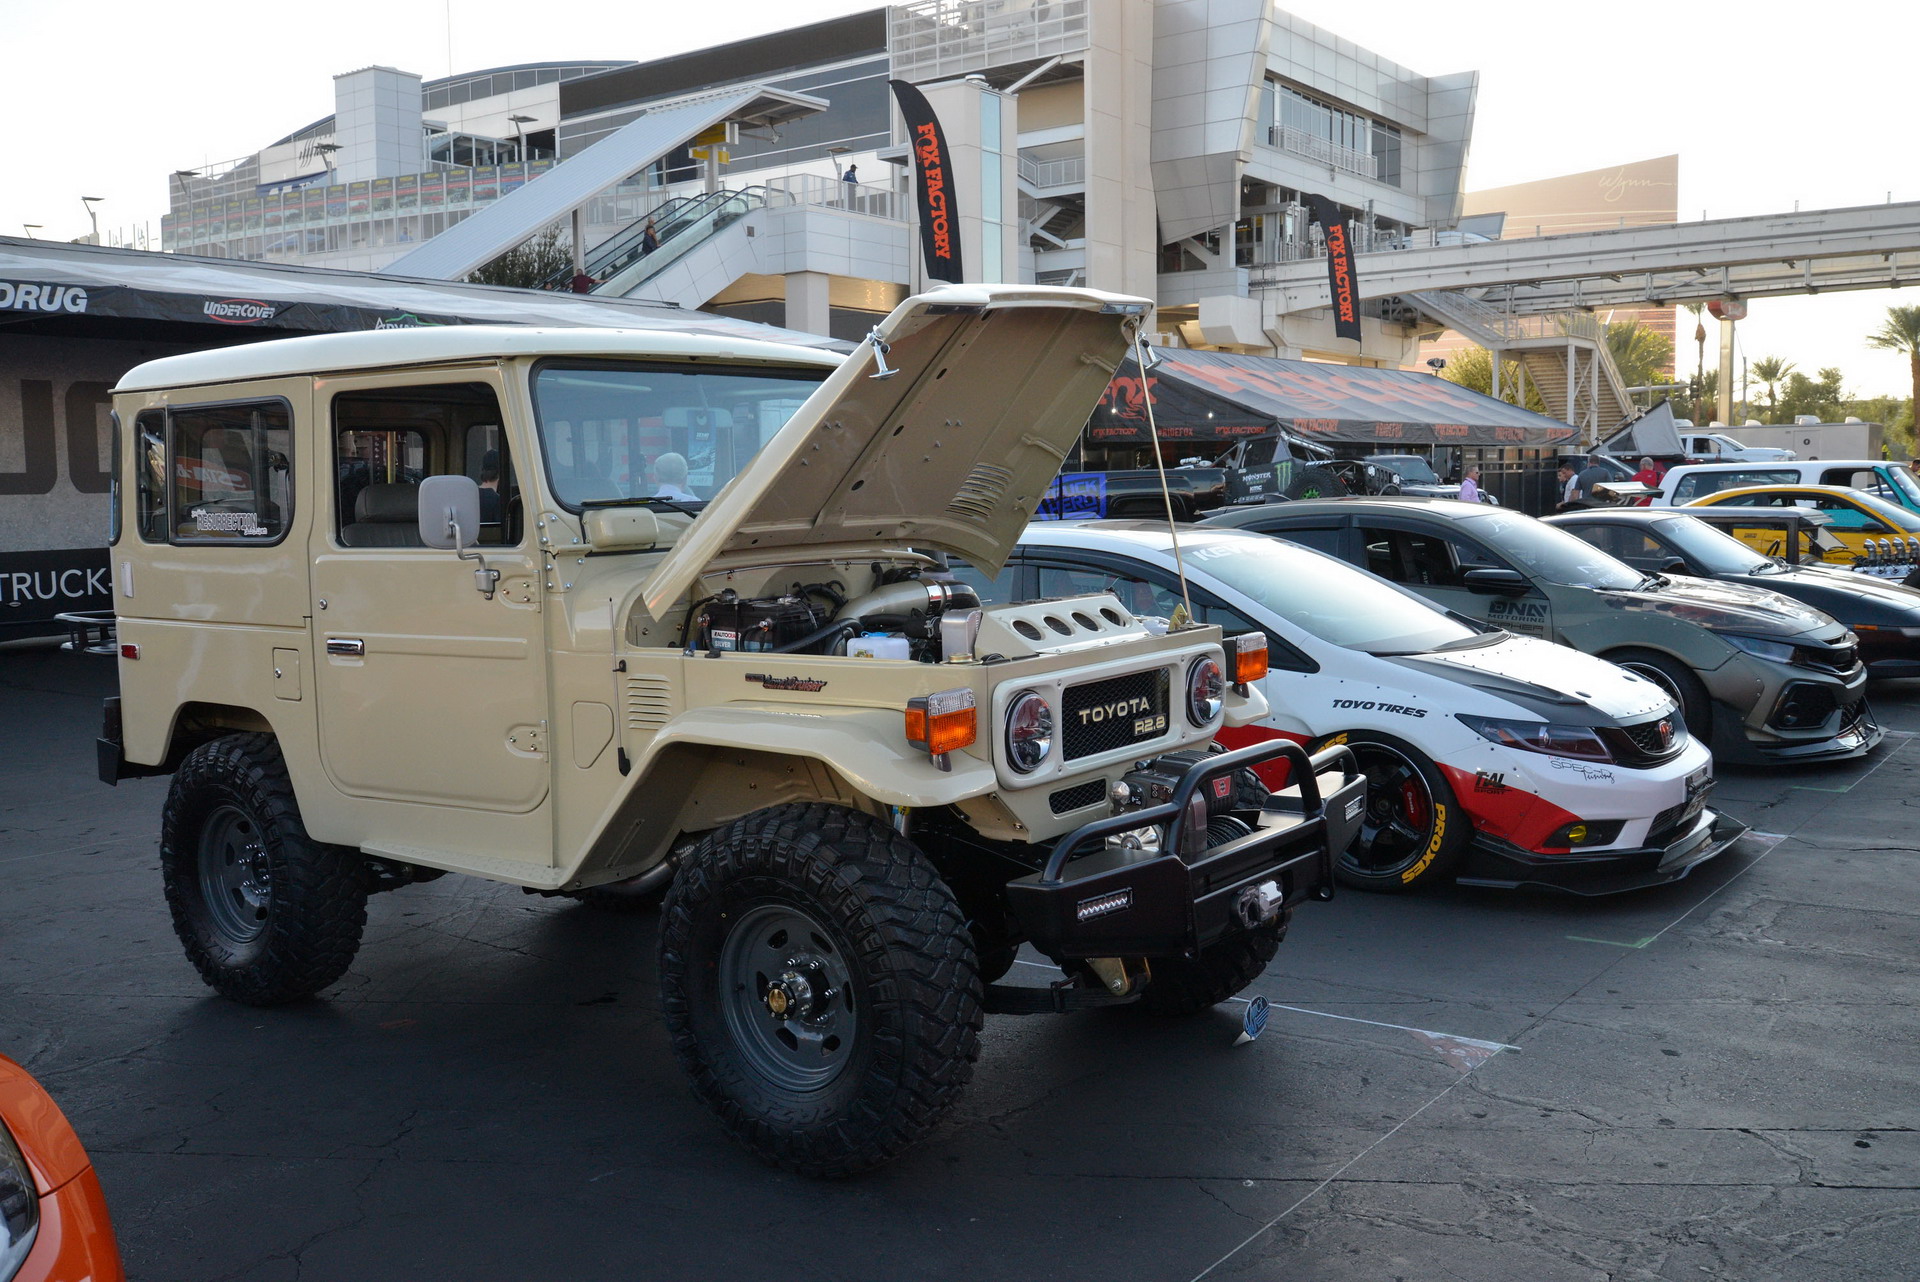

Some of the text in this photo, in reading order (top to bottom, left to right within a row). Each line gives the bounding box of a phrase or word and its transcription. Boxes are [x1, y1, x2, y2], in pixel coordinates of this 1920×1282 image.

[915, 122, 951, 259] FOX FACTORY
[1327, 224, 1354, 323] FOX FACTORY
[0, 282, 88, 312] DRUG
[197, 513, 258, 530] RESURRECTION
[1487, 614, 1545, 623] MOTORING
[714, 640, 732, 648] SILVER
[1078, 696, 1151, 725] TOYOTA
[1332, 699, 1428, 718] TOYO TIRES
[1134, 715, 1166, 735] R2.8
[1401, 803, 1446, 884] PROXES
